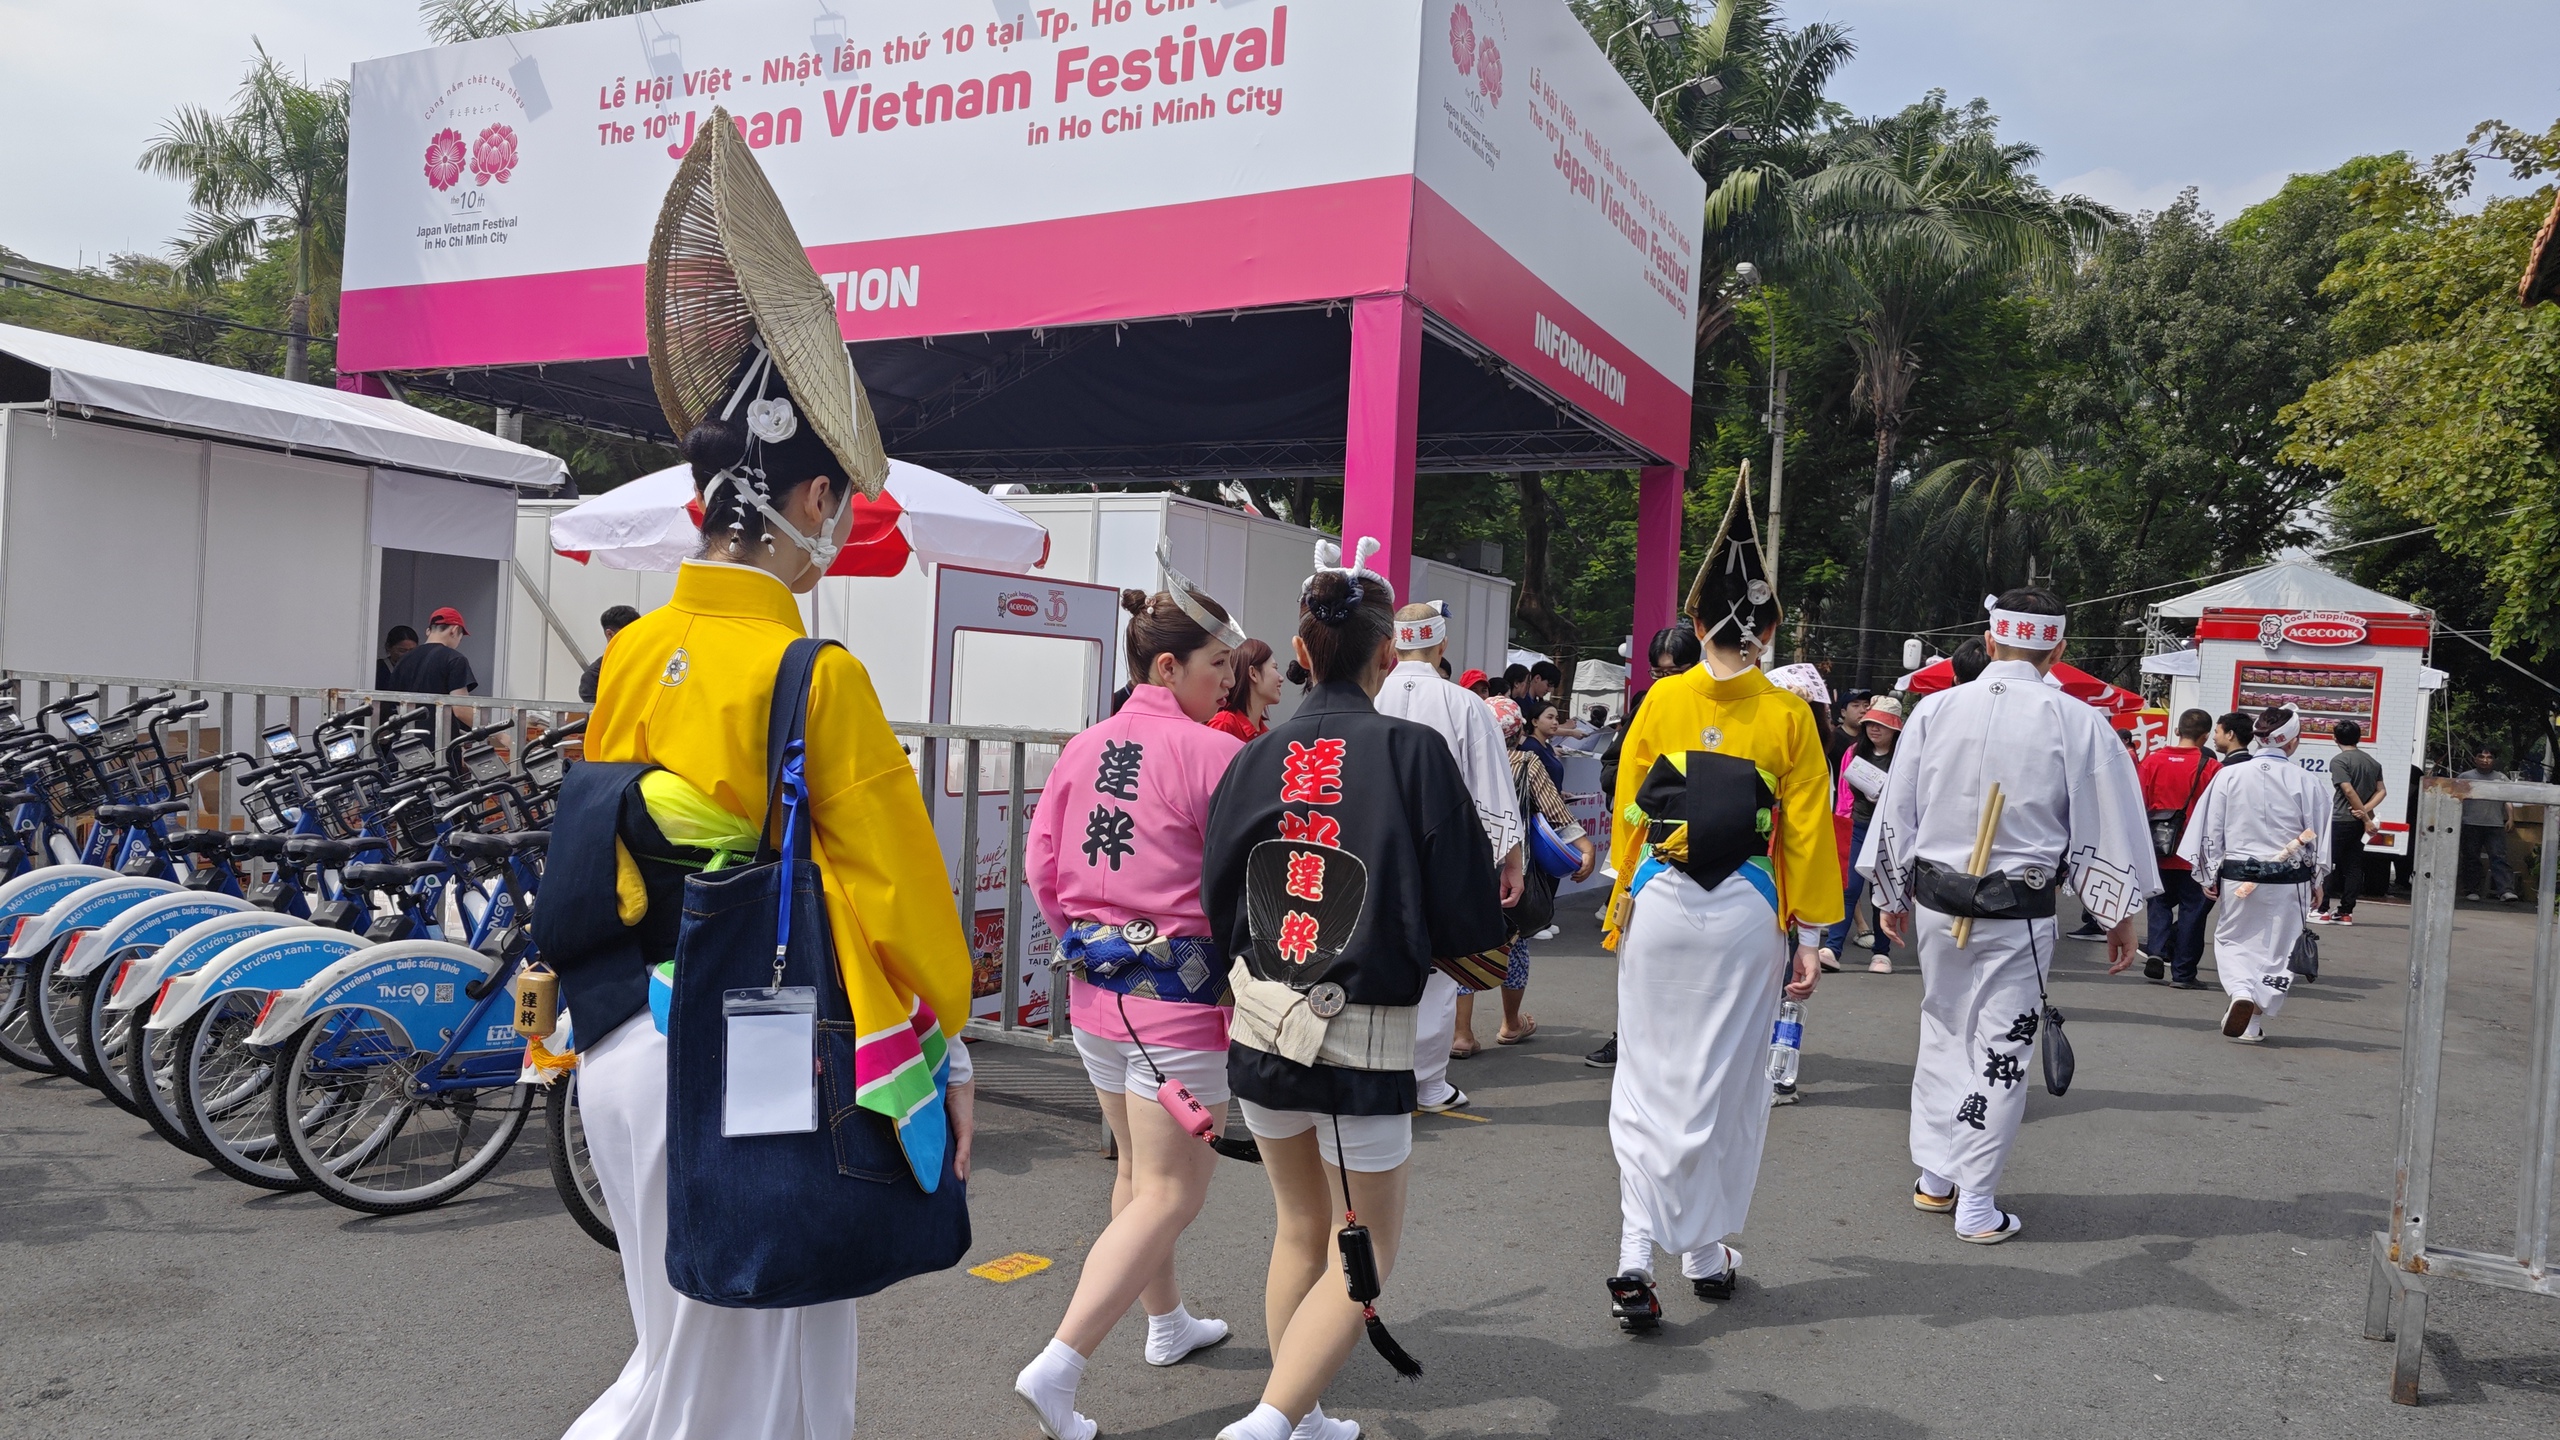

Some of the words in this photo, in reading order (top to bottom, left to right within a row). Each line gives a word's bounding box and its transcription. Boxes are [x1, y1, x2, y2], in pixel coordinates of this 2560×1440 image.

[598, 122, 635, 146] The
[642, 112, 680, 140] 10th
[667, 107, 803, 160] Jan
[822, 70, 1032, 137] Vietnam
[1054, 5, 1287, 103] Festival
[599, 76, 626, 110] Lễ
[635, 75, 673, 109] Hội
[683, 67, 732, 101] Việt
[762, 53, 823, 87] Nhật
[833, 38, 872, 74] lần
[883, 32, 931, 65] thứ
[942, 24, 975, 55] 10
[986, 14, 1024, 53] tại
[1036, 8, 1078, 43] Tp.
[491, 76, 506, 92] tay
[1027, 122, 1049, 146] in
[1058, 115, 1092, 141] Ho
[1101, 104, 1143, 135] Chi
[1152, 93, 1216, 127] Minh
[1226, 85, 1283, 117] City
[1443, 97, 1459, 122] Japan
[1460, 112, 1480, 142] Vietnam
[1481, 134, 1500, 160] Festival
[1447, 117, 1454, 130] in
[1454, 122, 1462, 139] Ho
[1462, 130, 1471, 148] Chi
[1472, 140, 1484, 161] Minh
[1485, 152, 1495, 172] City
[1543, 81, 1558, 116] Hội
[1560, 100, 1576, 136] Việt
[1584, 128, 1601, 164] Nhật
[1629, 179, 1638, 201] 10
[1528, 99, 1543, 131] The
[1553, 133, 1596, 204] Japan
[1600, 176, 1647, 256] Vietnam
[1650, 230, 1690, 295] Festival
[416, 224, 442, 238] Japan
[444, 221, 480, 235] Vietnam
[482, 216, 518, 230] Festival
[424, 238, 433, 250] in
[434, 238, 447, 249] Ho
[449, 235, 463, 247] Chi
[465, 233, 488, 246] Minh
[490, 232, 508, 244] City
[1643, 265, 1649, 282] in
[1649, 271, 1657, 289] Ho
[1657, 278, 1665, 298] Chi
[1677, 297, 1687, 320] City
[1534, 310, 1627, 407] INFORMATION
[2283, 612, 2310, 624] Cook
[2313, 611, 2365, 626] happiness
[2299, 758, 2331, 773] 122.
[6, 898, 25, 912] Môi
[24, 883, 57, 900] trường
[58, 878, 81, 888] xanh
[65, 911, 83, 926] Môi
[83, 896, 116, 913] trường
[117, 890, 140, 900] xanh
[177, 950, 198, 969] Môi
[196, 934, 234, 955] trường
[235, 928, 261, 940] xanh
[220, 967, 243, 988] Môi
[242, 949, 282, 971] trường
[284, 944, 312, 956] xanh
[324, 988, 344, 1004] Môi
[343, 971, 372, 993] trường
[396, 957, 418, 971] Cuộc
